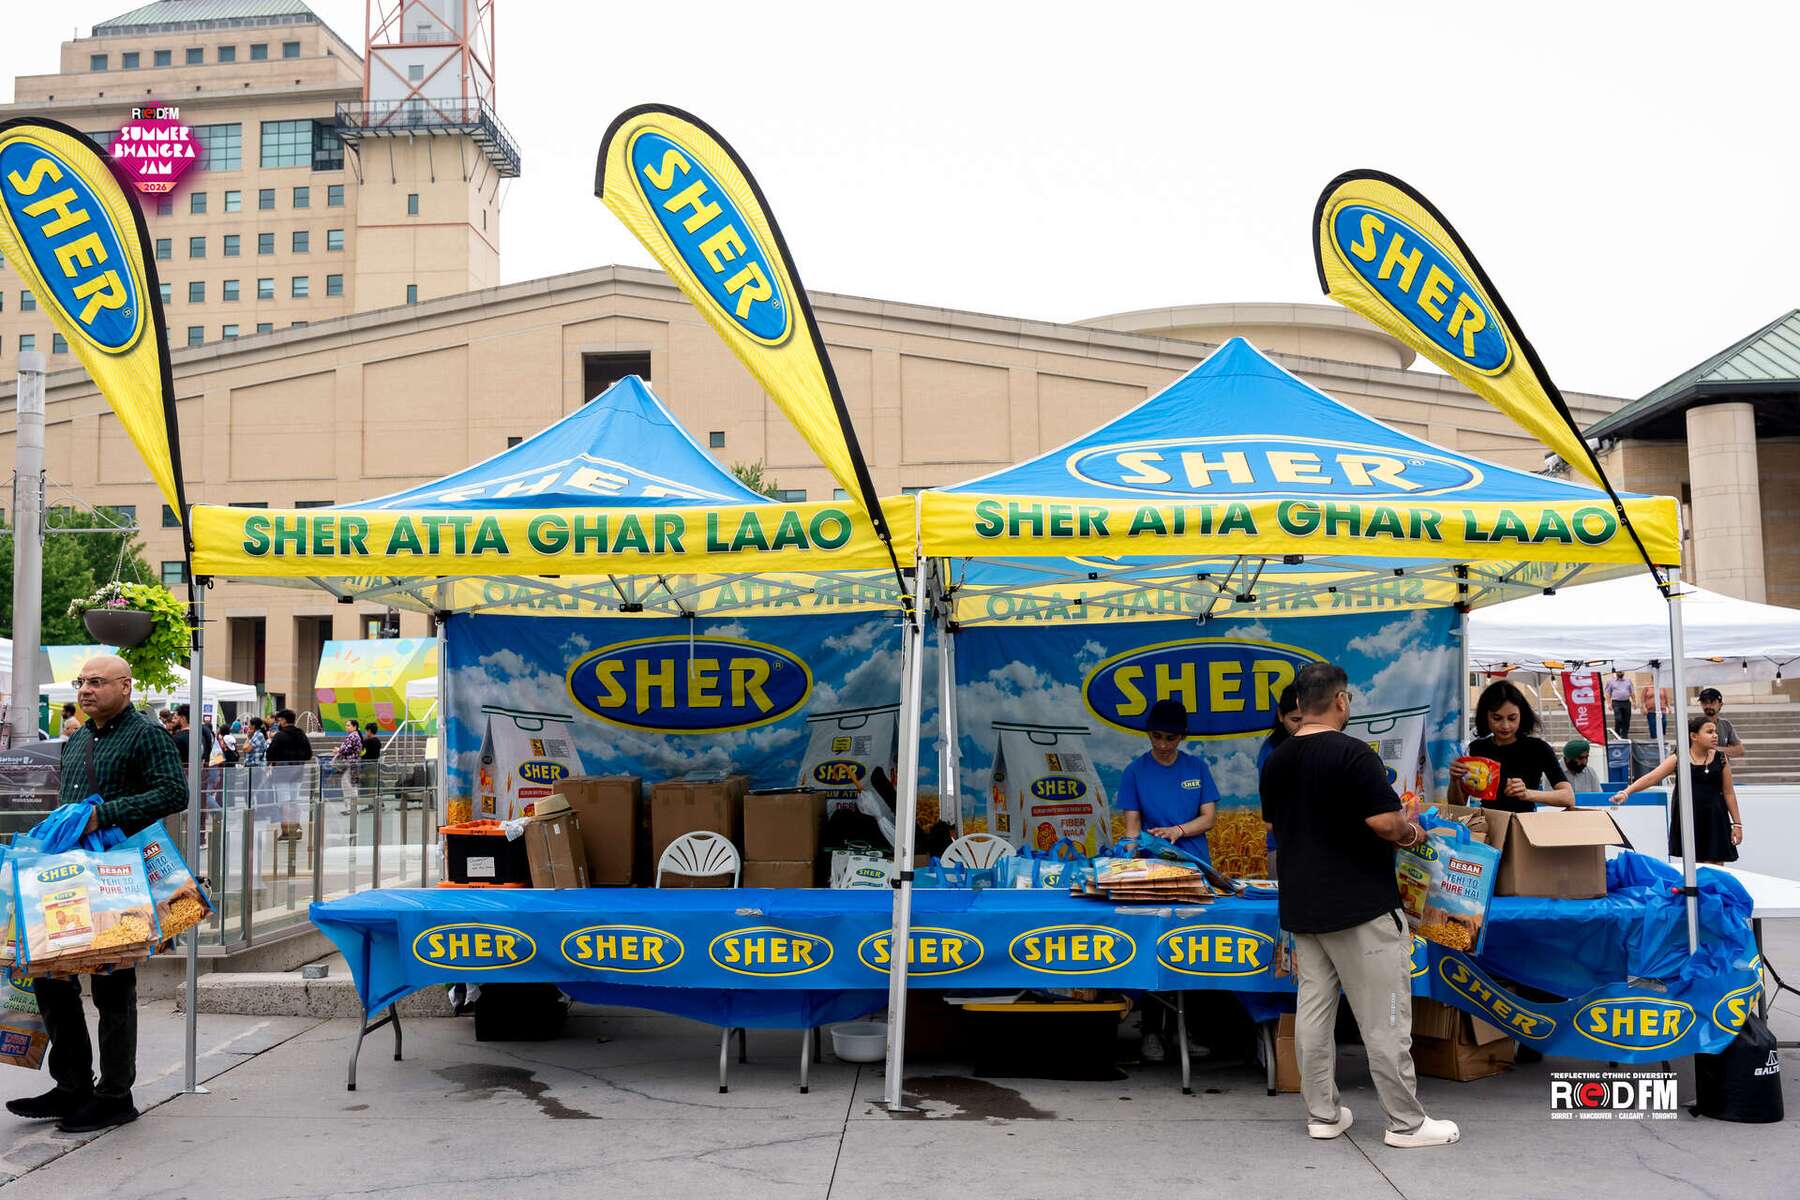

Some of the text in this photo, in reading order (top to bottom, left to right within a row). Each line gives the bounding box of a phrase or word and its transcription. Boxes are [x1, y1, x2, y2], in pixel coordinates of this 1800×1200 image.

[7, 158, 128, 325] SHER
[643, 149, 773, 319] SHER
[1350, 213, 1486, 358] SHER
[1115, 451, 1424, 492] SHER
[243, 508, 853, 557] SHER ATTA GHAR LAAO
[975, 499, 1619, 546] SHER ATTA GHAR LAAO
[595, 657, 776, 715] SHER
[1113, 659, 1295, 716] SHER
[525, 763, 561, 779] SHER
[1037, 781, 1079, 796] SHER
[1061, 818, 1086, 827] FIBER
[1408, 843, 1434, 860] HER
[41, 864, 80, 881] SHER
[99, 867, 131, 875] BESAN
[1450, 860, 1481, 874] BESAN
[1440, 880, 1463, 895] PURE
[428, 934, 517, 960] SHER
[575, 935, 665, 965] SHER
[724, 937, 814, 966] SHER
[873, 938, 965, 966] SER
[1023, 935, 1117, 965] SHER
[1168, 936, 1261, 968] SHER
[1450, 964, 1540, 1036] SHER
[1590, 1007, 1681, 1038] SHER
